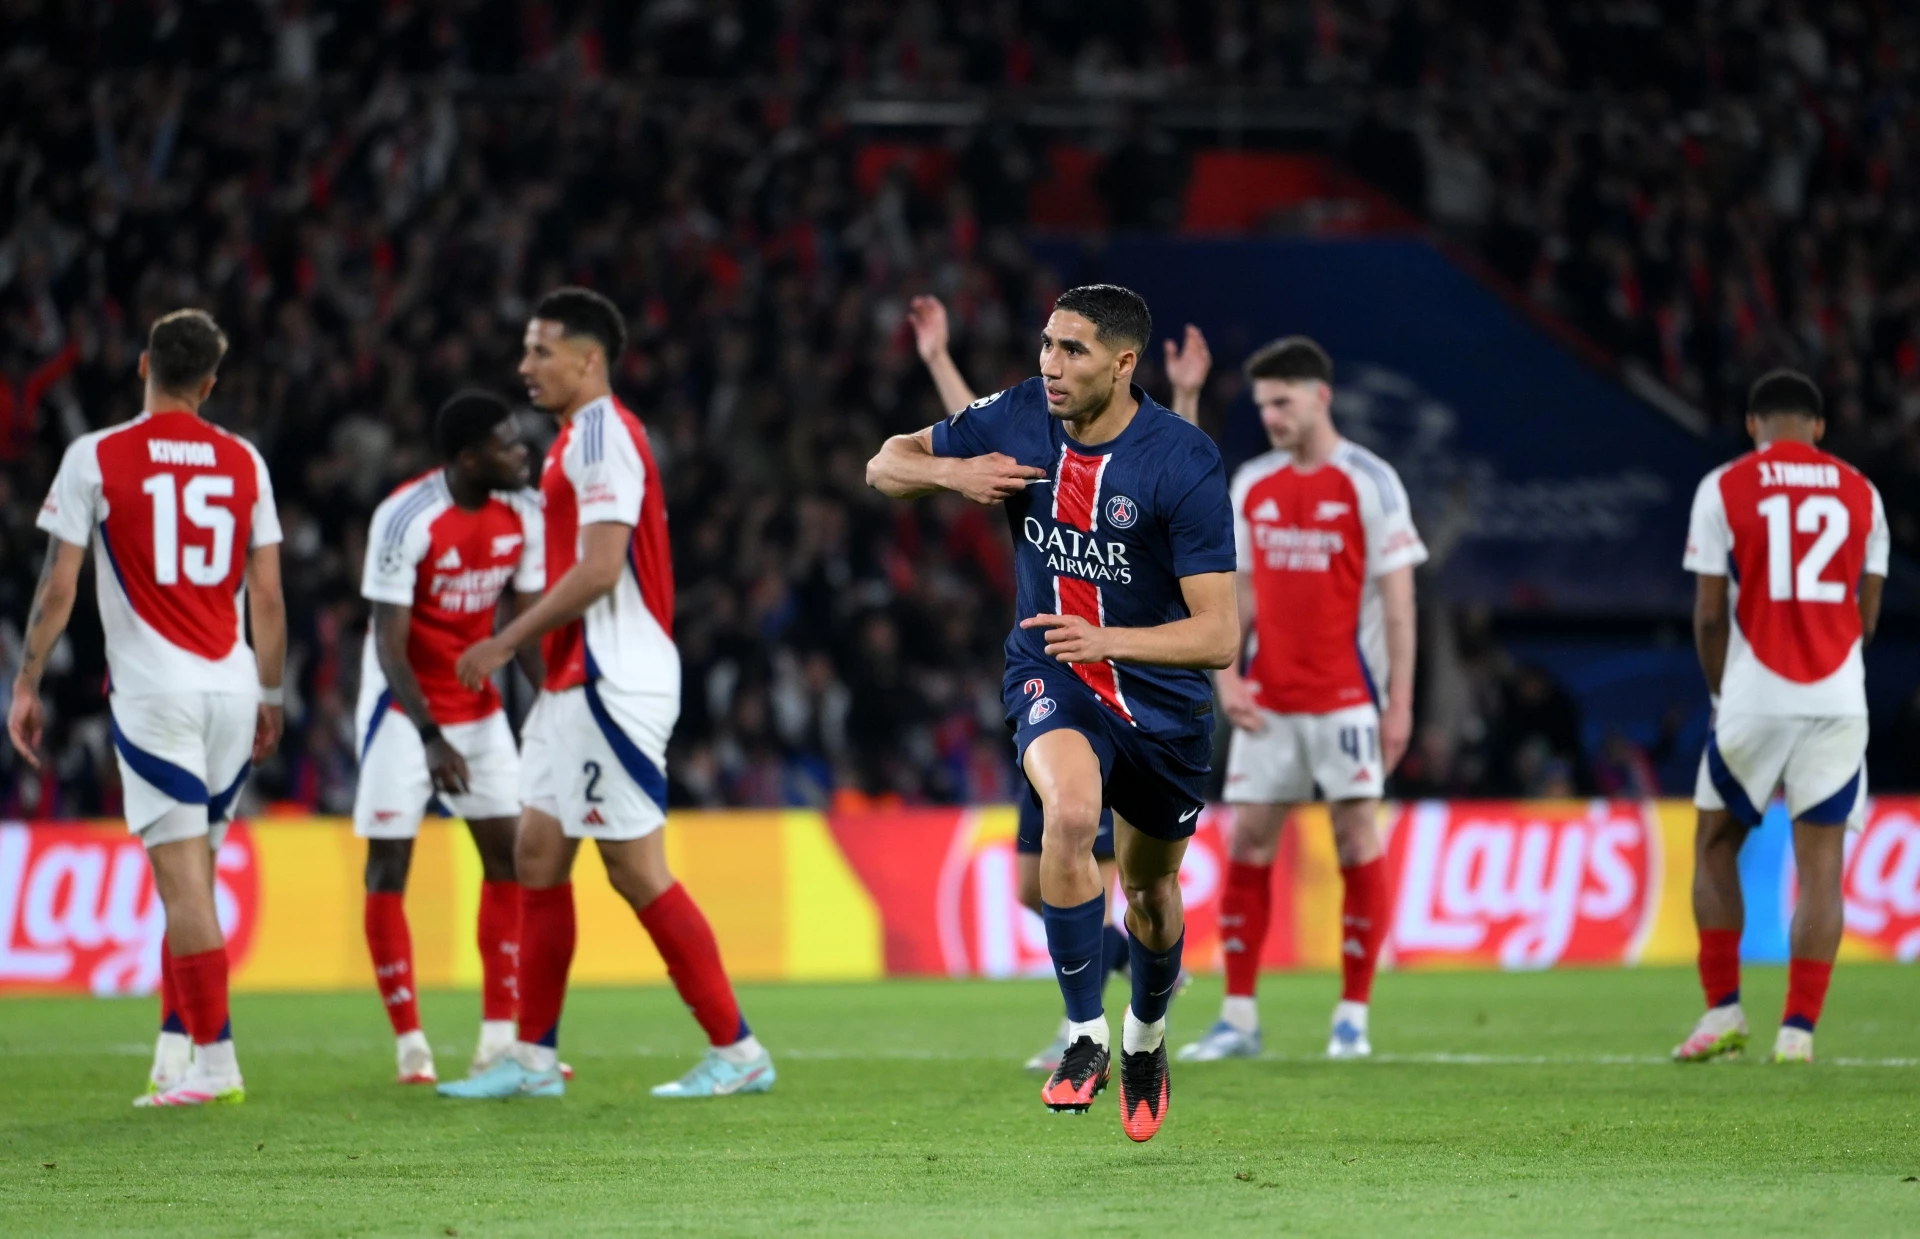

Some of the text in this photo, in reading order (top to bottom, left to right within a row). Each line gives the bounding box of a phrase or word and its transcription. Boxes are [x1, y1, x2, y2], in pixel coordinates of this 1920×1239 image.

[147, 438, 217, 467] KIWIOR
[1112, 497, 1133, 508] PARIS
[142, 472, 236, 587] 15
[1023, 516, 1131, 567] QATAR
[1757, 493, 1850, 604] 12
[1046, 553, 1132, 585] AIRWAYS
[1338, 724, 1376, 763] 41
[583, 760, 604, 803] 2
[1394, 797, 1641, 970] Lay's
